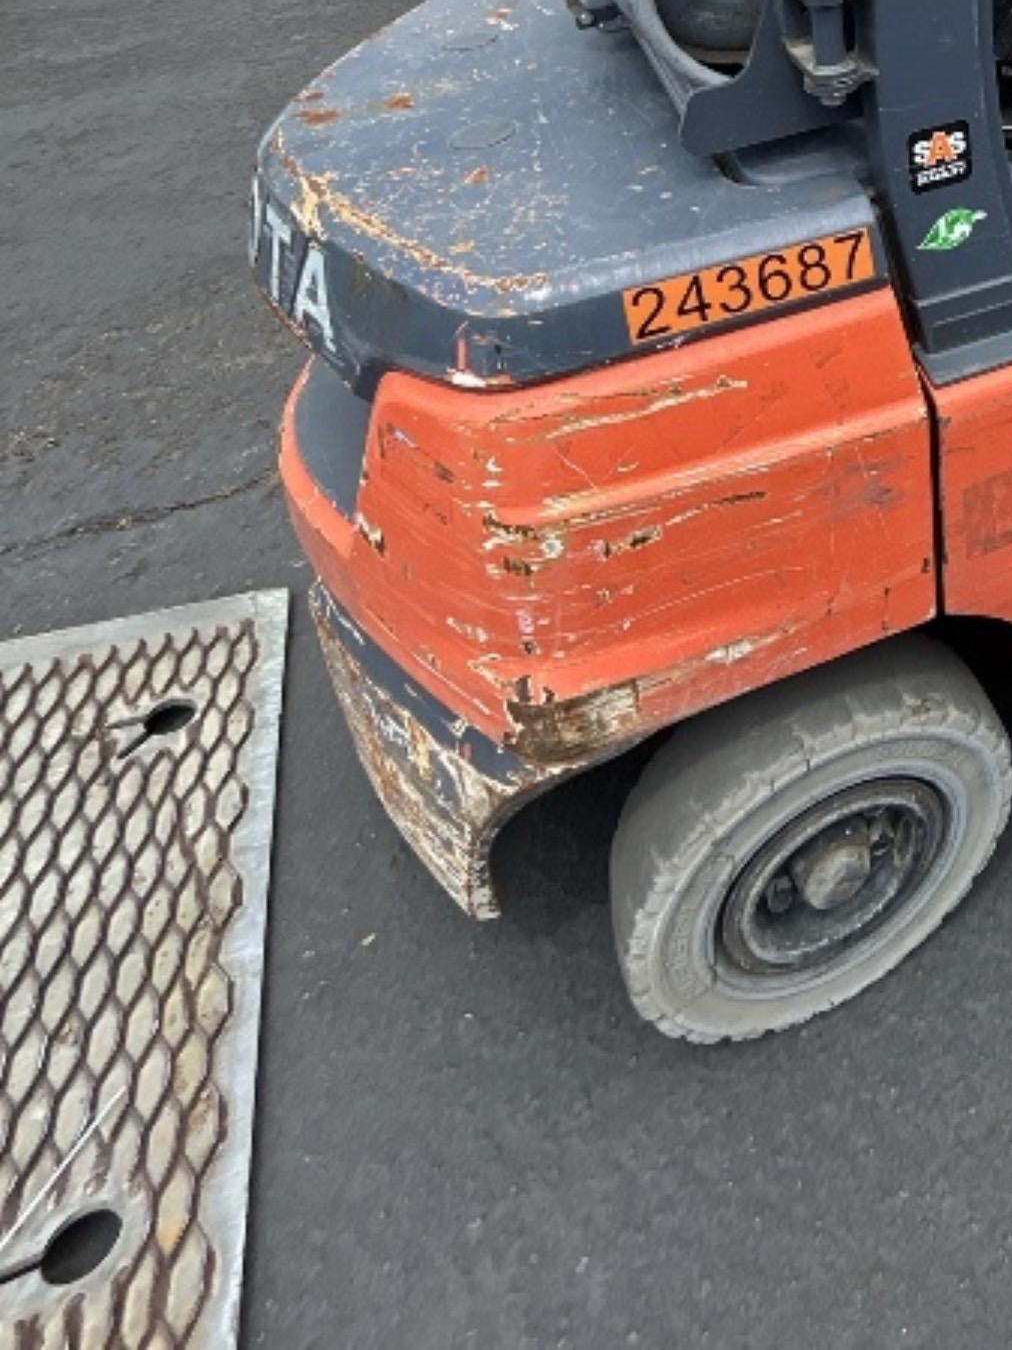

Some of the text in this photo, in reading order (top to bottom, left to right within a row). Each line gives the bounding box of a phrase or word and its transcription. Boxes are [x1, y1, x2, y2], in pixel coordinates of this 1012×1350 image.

[912, 131, 967, 167] SAS
[248, 176, 337, 354] TA
[630, 233, 866, 342] 243687
